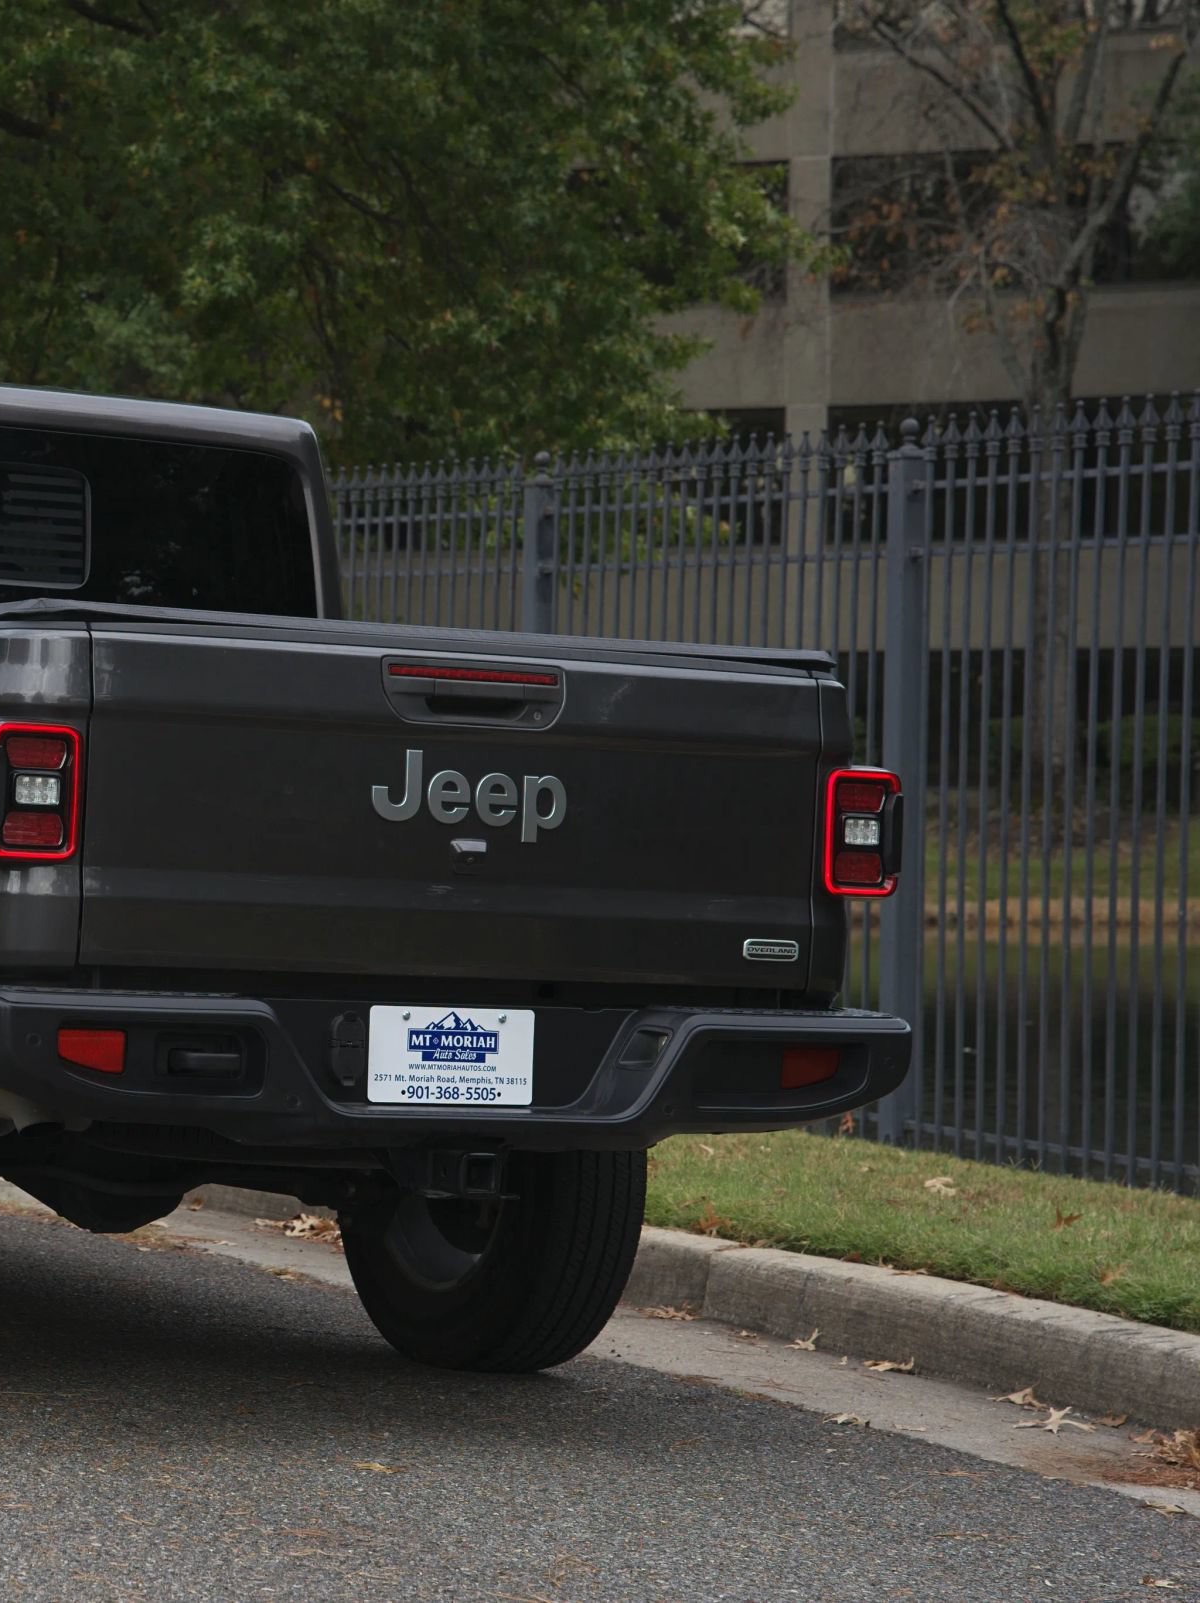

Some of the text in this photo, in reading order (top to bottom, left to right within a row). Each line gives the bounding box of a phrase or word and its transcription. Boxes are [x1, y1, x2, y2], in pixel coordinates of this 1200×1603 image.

[371, 748, 567, 843] Jeep
[747, 946, 797, 954] OVERLAND
[410, 1034, 495, 1049] MT MORIAH
[432, 1048, 477, 1061] Auto Sales
[408, 1063, 497, 1072] WWW.MTMORIAHAUTOS.COM
[374, 1074, 527, 1086] 2571 Mt. Moriah Road, Memphis, TN 38115
